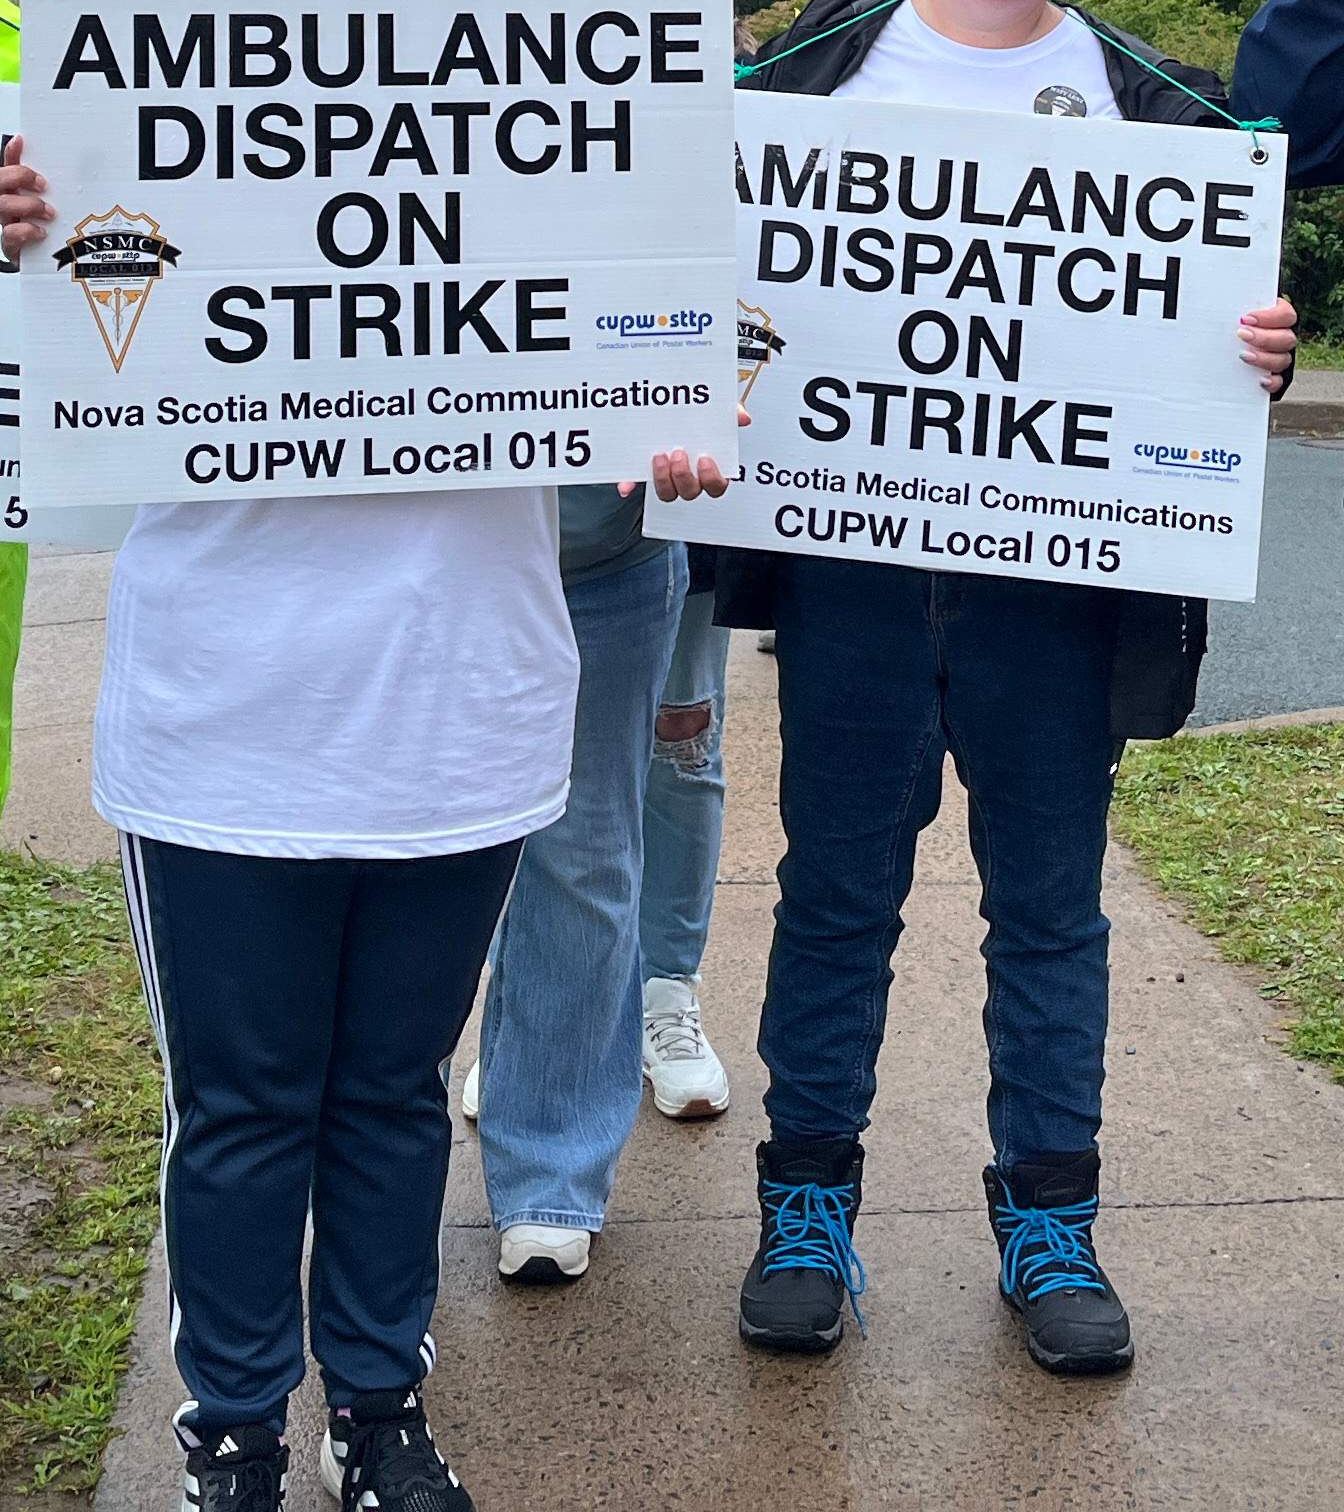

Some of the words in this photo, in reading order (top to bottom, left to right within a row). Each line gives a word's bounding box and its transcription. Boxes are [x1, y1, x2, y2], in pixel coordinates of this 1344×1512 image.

[52, 10, 704, 90] AMBULANCE
[138, 99, 631, 181] DISPATCH
[83, 235, 153, 253] NSMC
[316, 191, 461, 269] ON
[757, 219, 1181, 320] DISPATCH
[204, 277, 571, 364] STRIKE
[738, 325, 764, 339] MC
[898, 309, 1023, 383] ON
[54, 400, 145, 430] Nova
[156, 396, 268, 426] Scotia
[281, 388, 415, 421] Medical
[427, 381, 710, 415] Communications
[798, 376, 1113, 470] STRIKE
[184, 438, 347, 484] CUPW
[363, 432, 492, 476] Local
[508, 429, 591, 470] 015
[755, 461, 846, 493] Scotia
[856, 471, 970, 506] Medical
[980, 484, 1233, 535] Communications
[774, 504, 909, 549] CUPW
[921, 519, 1034, 564] Local
[1047, 534, 1121, 573] 015
